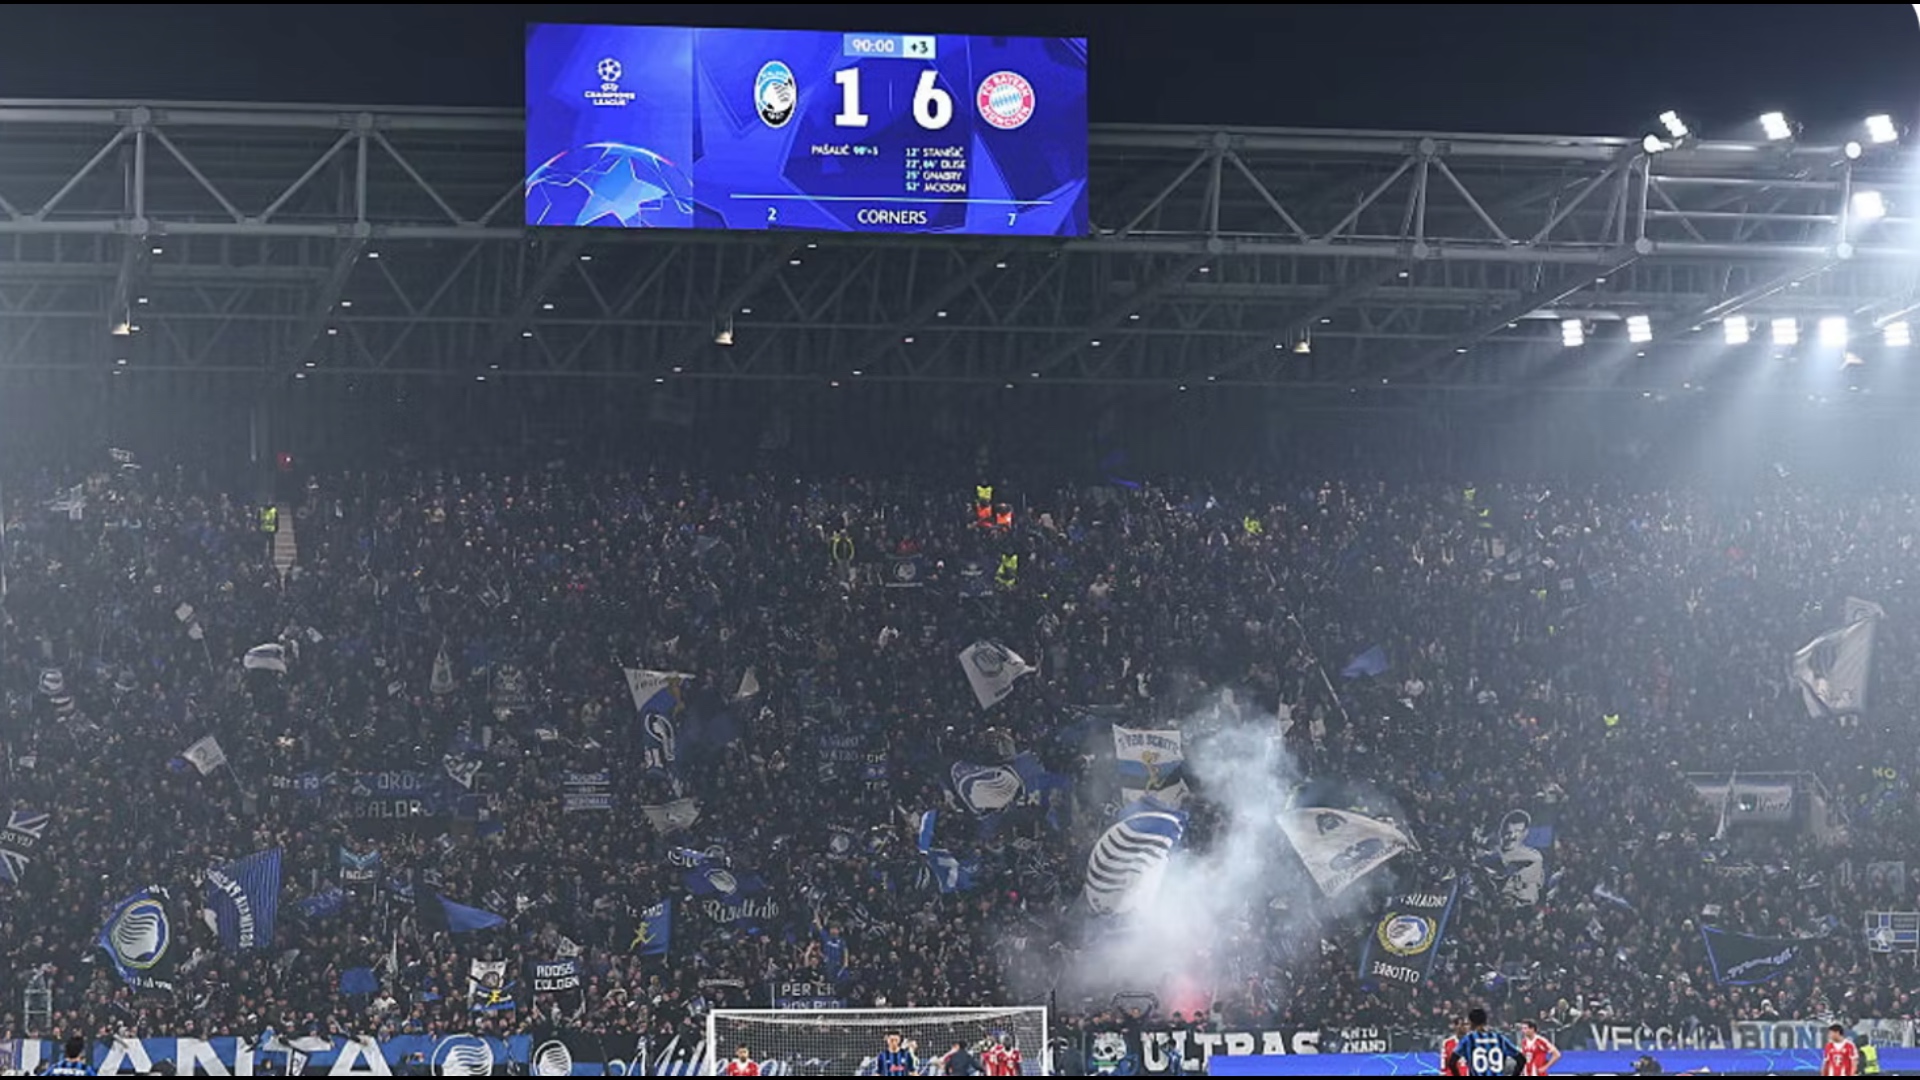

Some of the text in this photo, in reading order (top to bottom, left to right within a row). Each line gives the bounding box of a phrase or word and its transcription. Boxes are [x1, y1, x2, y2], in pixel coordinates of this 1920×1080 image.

[852, 39, 929, 54] 90:00 +3
[835, 67, 869, 127] 1
[913, 70, 953, 130] 6
[923, 182, 966, 193] JACKSON
[767, 207, 1017, 227] 2 CORNERS 7
[780, 983, 812, 997] PER
[1140, 1030, 1321, 1073] ULTRAS
[1472, 1046, 1504, 1073] 69
